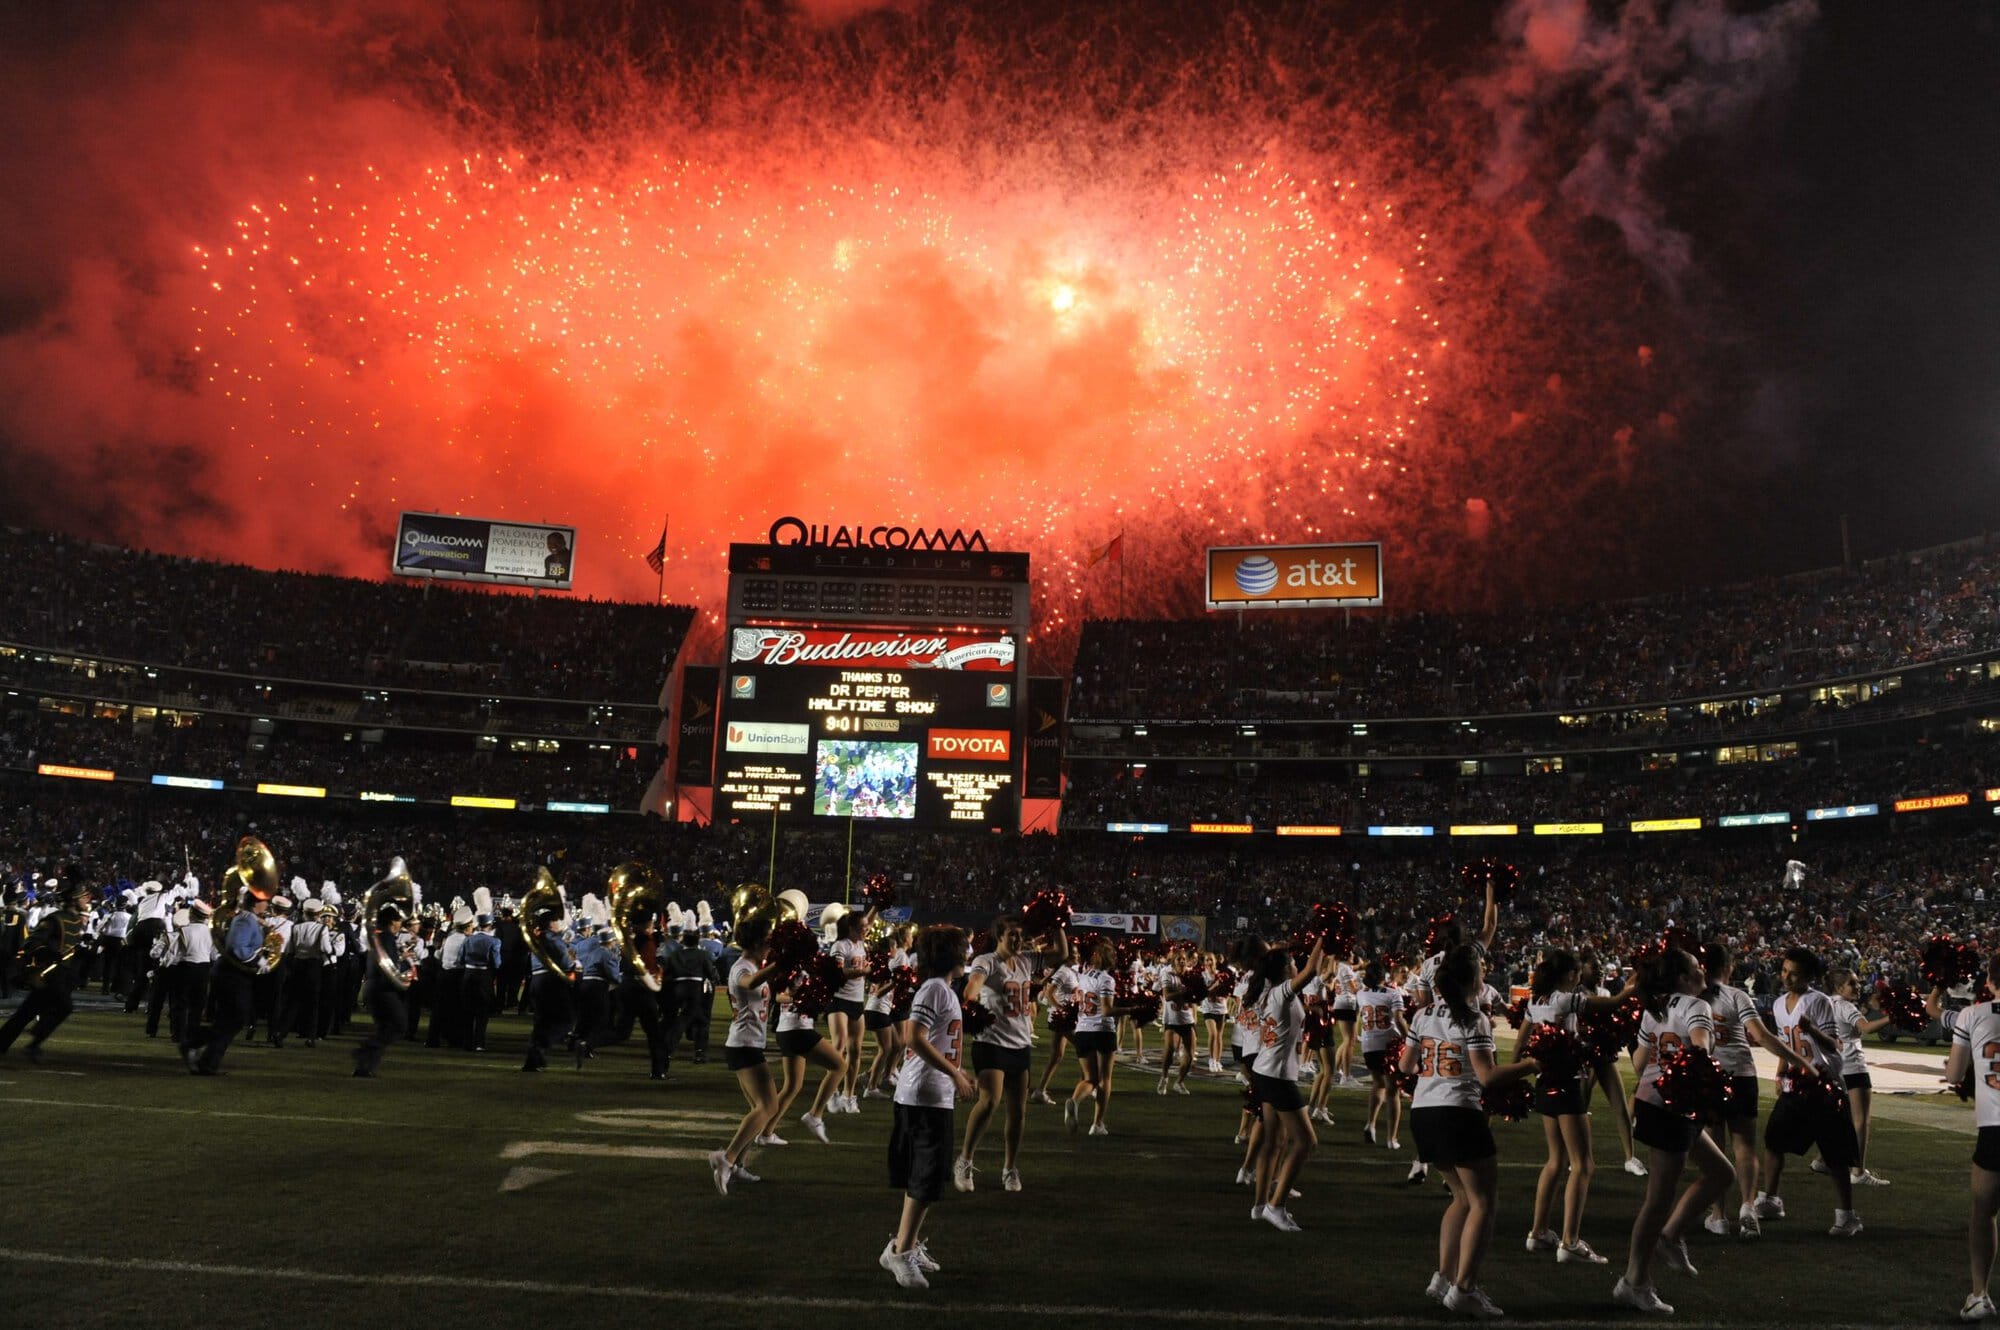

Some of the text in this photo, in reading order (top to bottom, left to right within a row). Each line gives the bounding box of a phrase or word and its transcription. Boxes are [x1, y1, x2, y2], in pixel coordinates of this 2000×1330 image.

[405, 530, 484, 548] QUALCOMM
[493, 528, 545, 540] PALOMAR
[769, 516, 989, 551] QUALCOMM
[492, 538, 545, 549] POMERADO
[491, 546, 545, 557] HEALTH
[815, 554, 971, 569] STADIUM
[1286, 558, 1357, 587] at&t
[758, 632, 948, 665] Budweiser
[949, 647, 1012, 664] American Lager
[841, 671, 901, 684] THANKS TO
[830, 684, 910, 699] DR PEPPER
[808, 698, 935, 714] HALFTIME SHOW
[682, 723, 713, 737] Sprint
[748, 732, 807, 744] UnionBank
[932, 736, 1005, 754] TOYOTA
[927, 772, 1011, 783] THE PACIFIC LIFE
[936, 780, 975, 788] HOLIDAY
[1897, 795, 1968, 811] WELLS FARGO
[1193, 825, 1252, 833] WELLS FARGO
[1131, 916, 1151, 932] N
